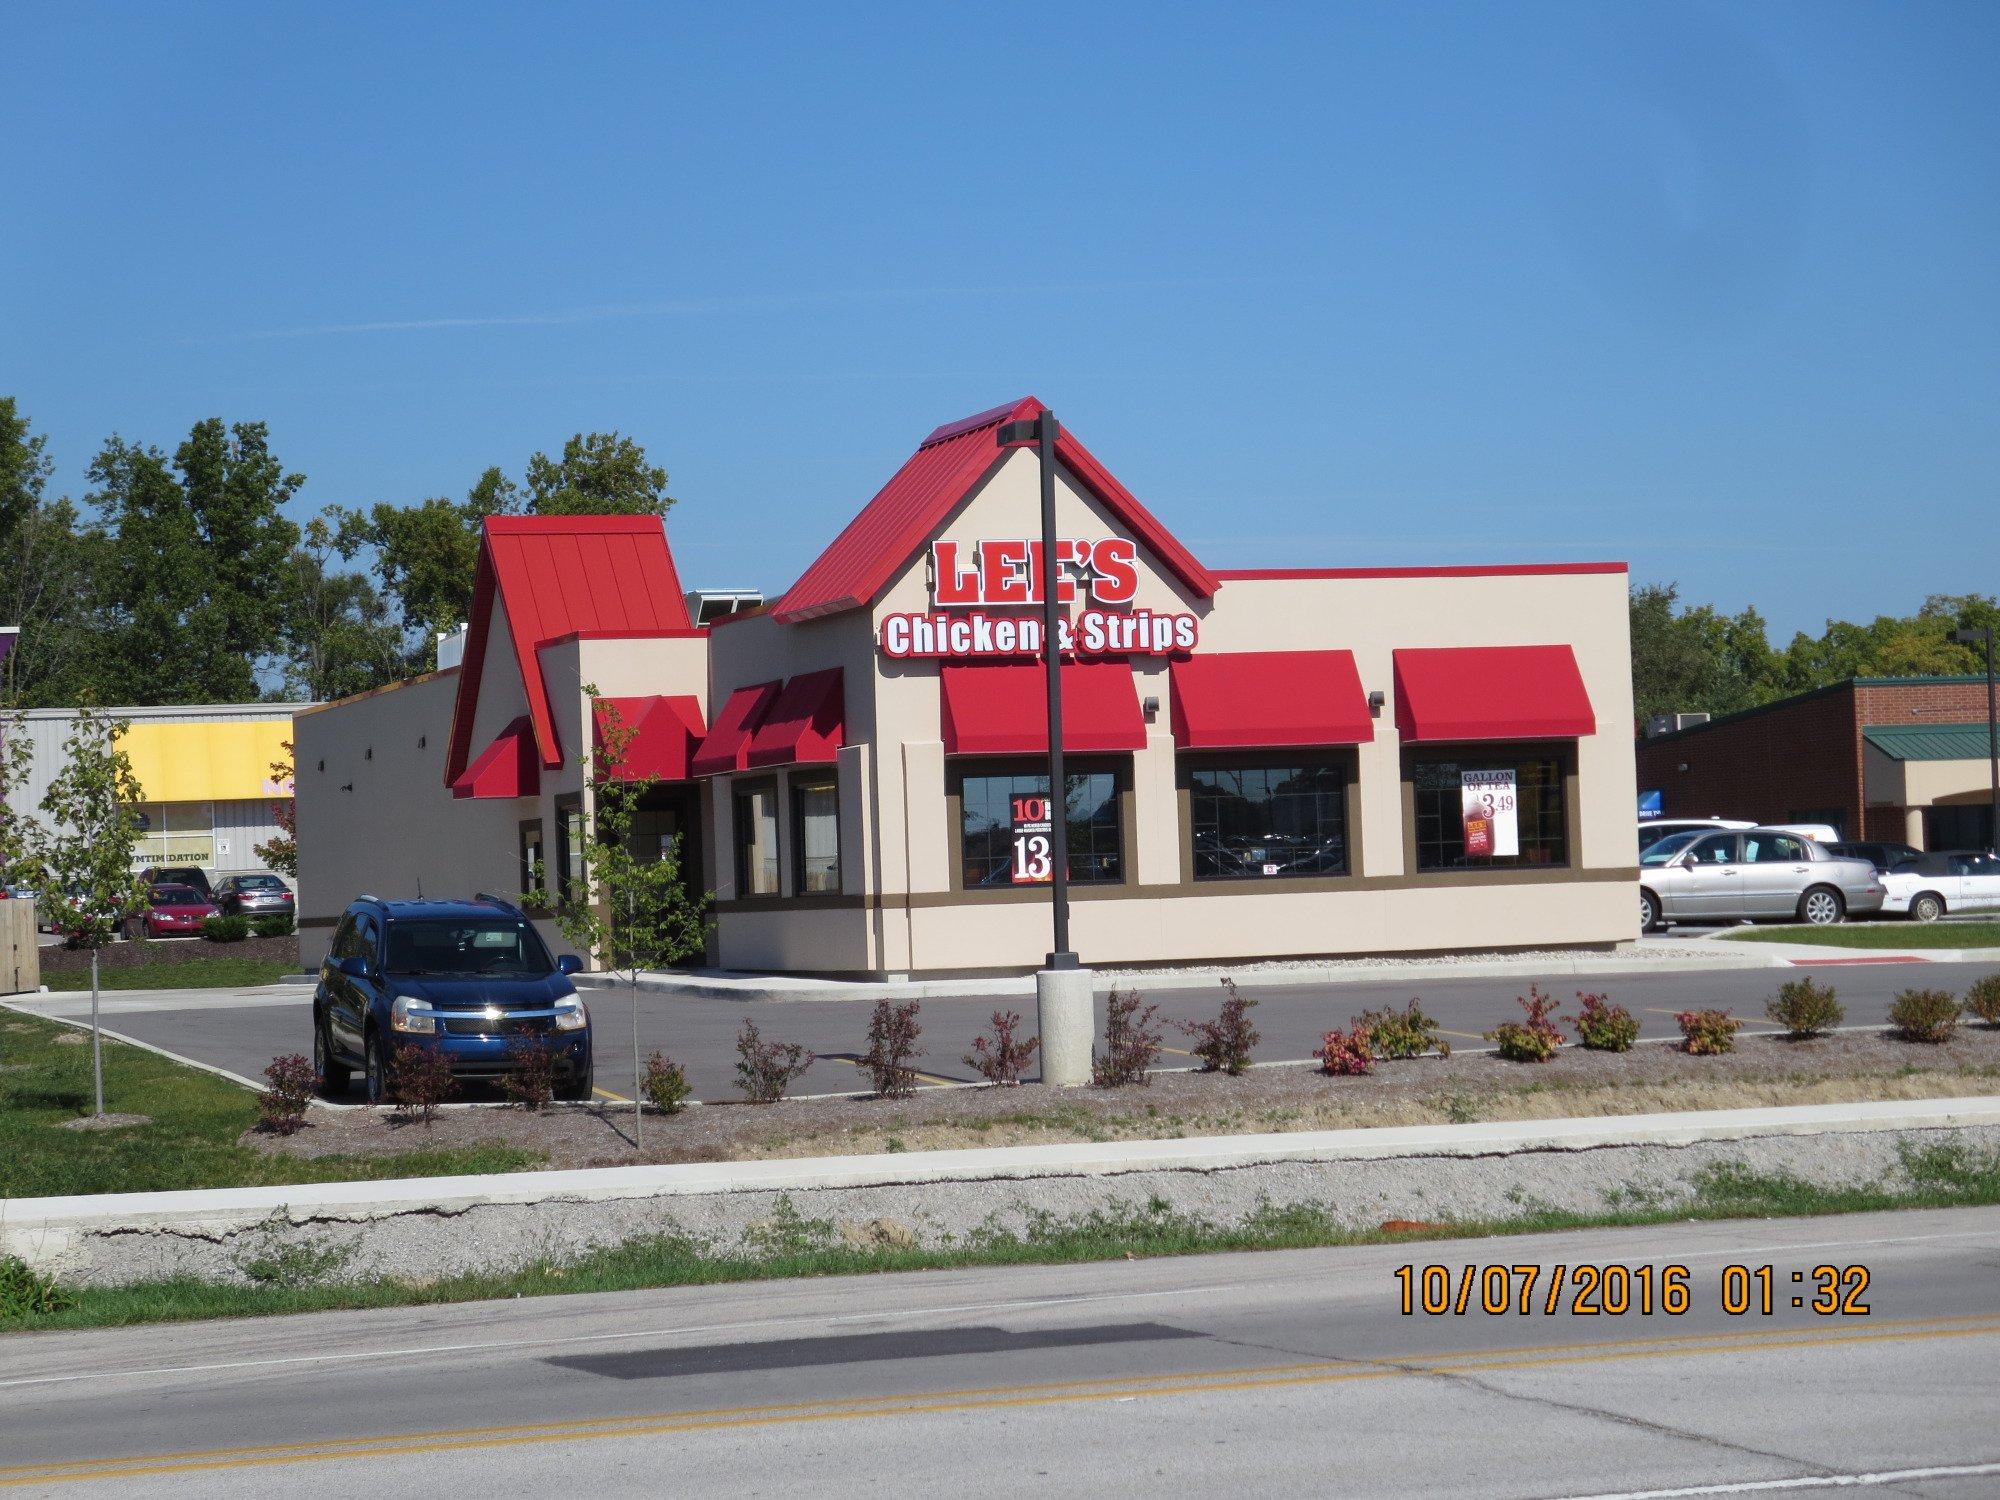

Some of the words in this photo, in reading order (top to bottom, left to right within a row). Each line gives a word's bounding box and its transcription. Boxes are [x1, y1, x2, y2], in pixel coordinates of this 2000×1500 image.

[932, 538, 1139, 607] LEE'S
[887, 614, 1041, 654] Chicken
[1084, 611, 1196, 652] Strips
[1464, 772, 1513, 782] GALLON
[1468, 782, 1483, 791] OF
[1487, 781, 1511, 791] TEA
